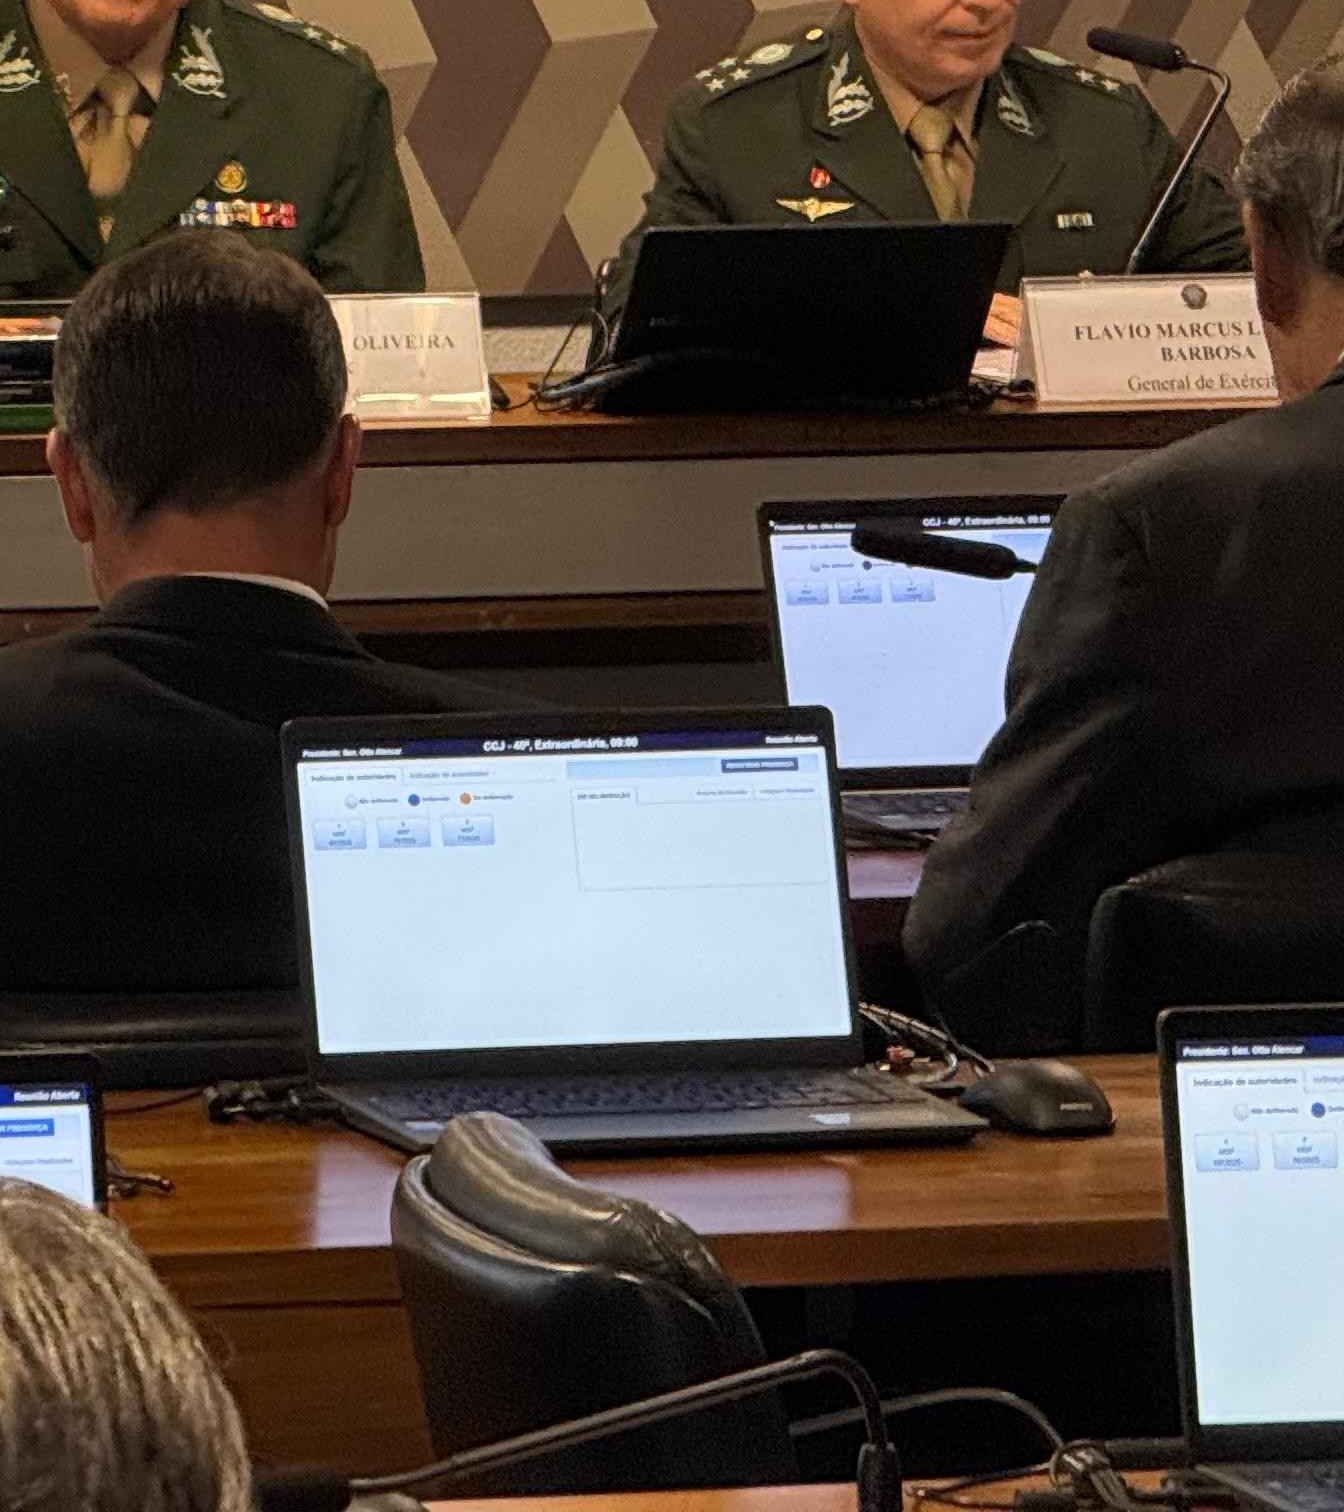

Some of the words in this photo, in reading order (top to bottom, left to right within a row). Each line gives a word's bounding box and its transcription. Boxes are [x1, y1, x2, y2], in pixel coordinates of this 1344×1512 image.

[1075, 322, 1151, 340] FLAVIO
[1157, 320, 1242, 339] MARCUS
[1248, 321, 1262, 335] L
[352, 334, 455, 351] OLIVEIRA
[1161, 345, 1257, 363] BARBOSA
[1127, 374, 1191, 392] General
[1194, 374, 1214, 390] de
